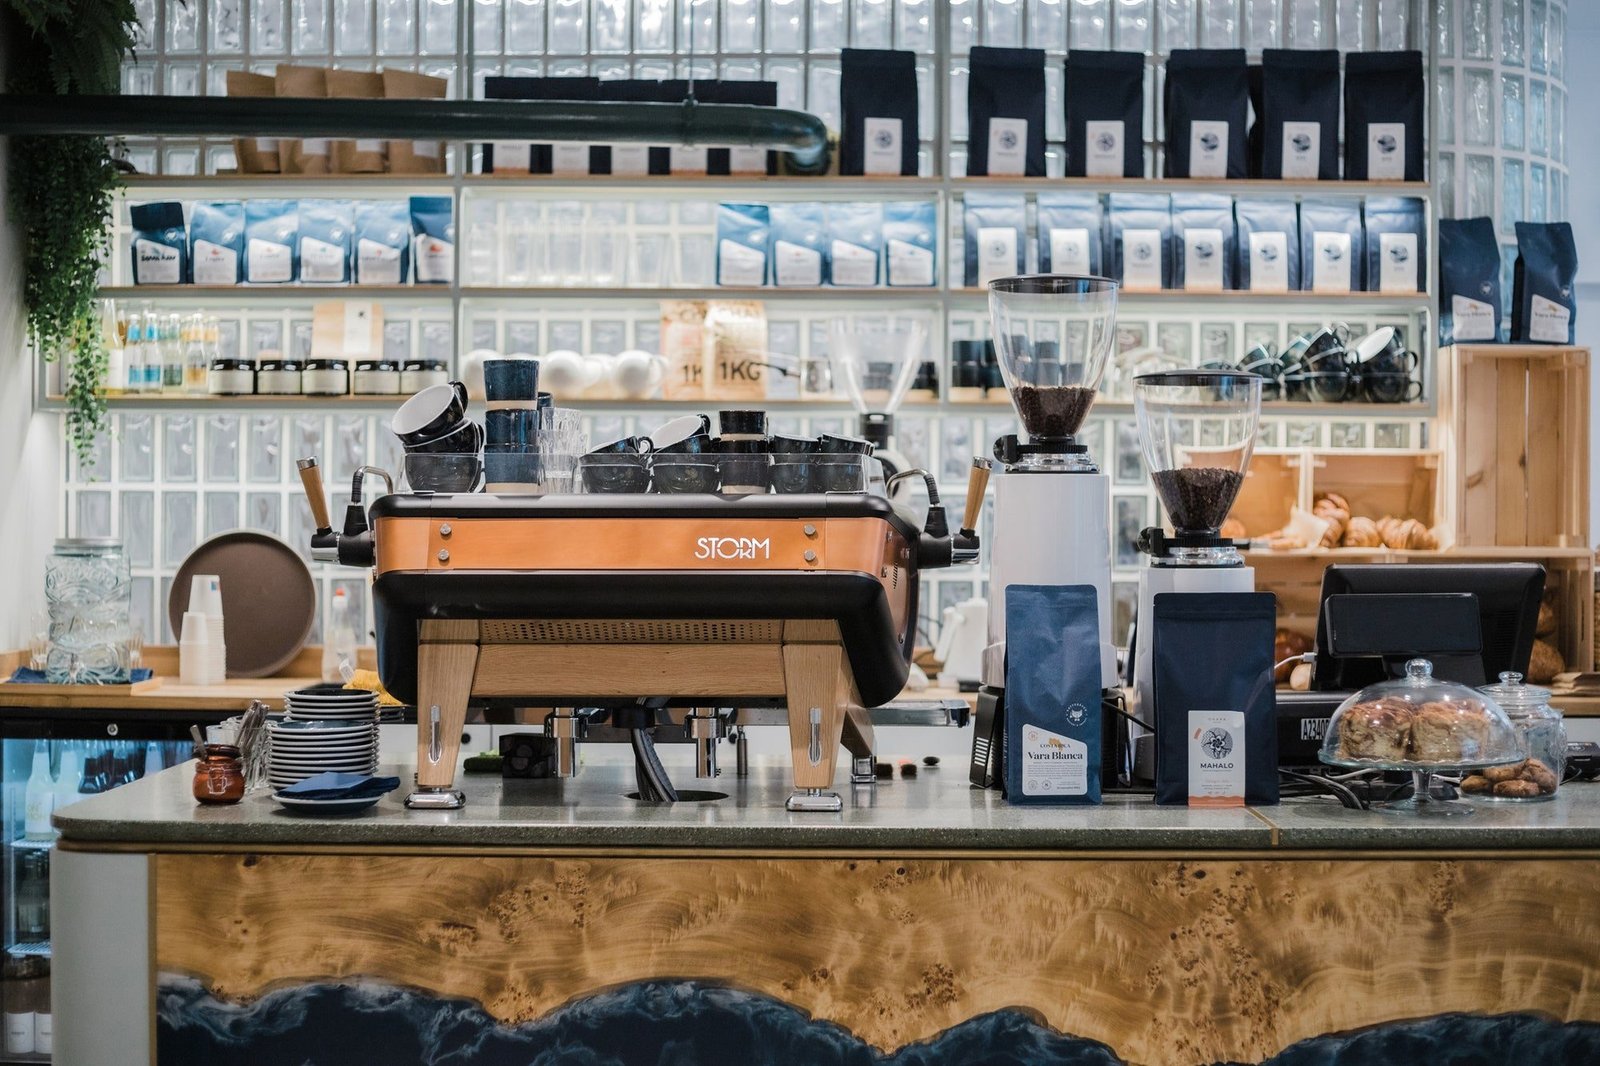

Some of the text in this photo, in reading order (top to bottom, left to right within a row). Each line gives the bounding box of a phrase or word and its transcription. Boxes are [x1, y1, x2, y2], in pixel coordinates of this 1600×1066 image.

[720, 360, 761, 381] 1KG
[694, 537, 770, 559] STORM
[1027, 751, 1083, 760] Vara Blanca
